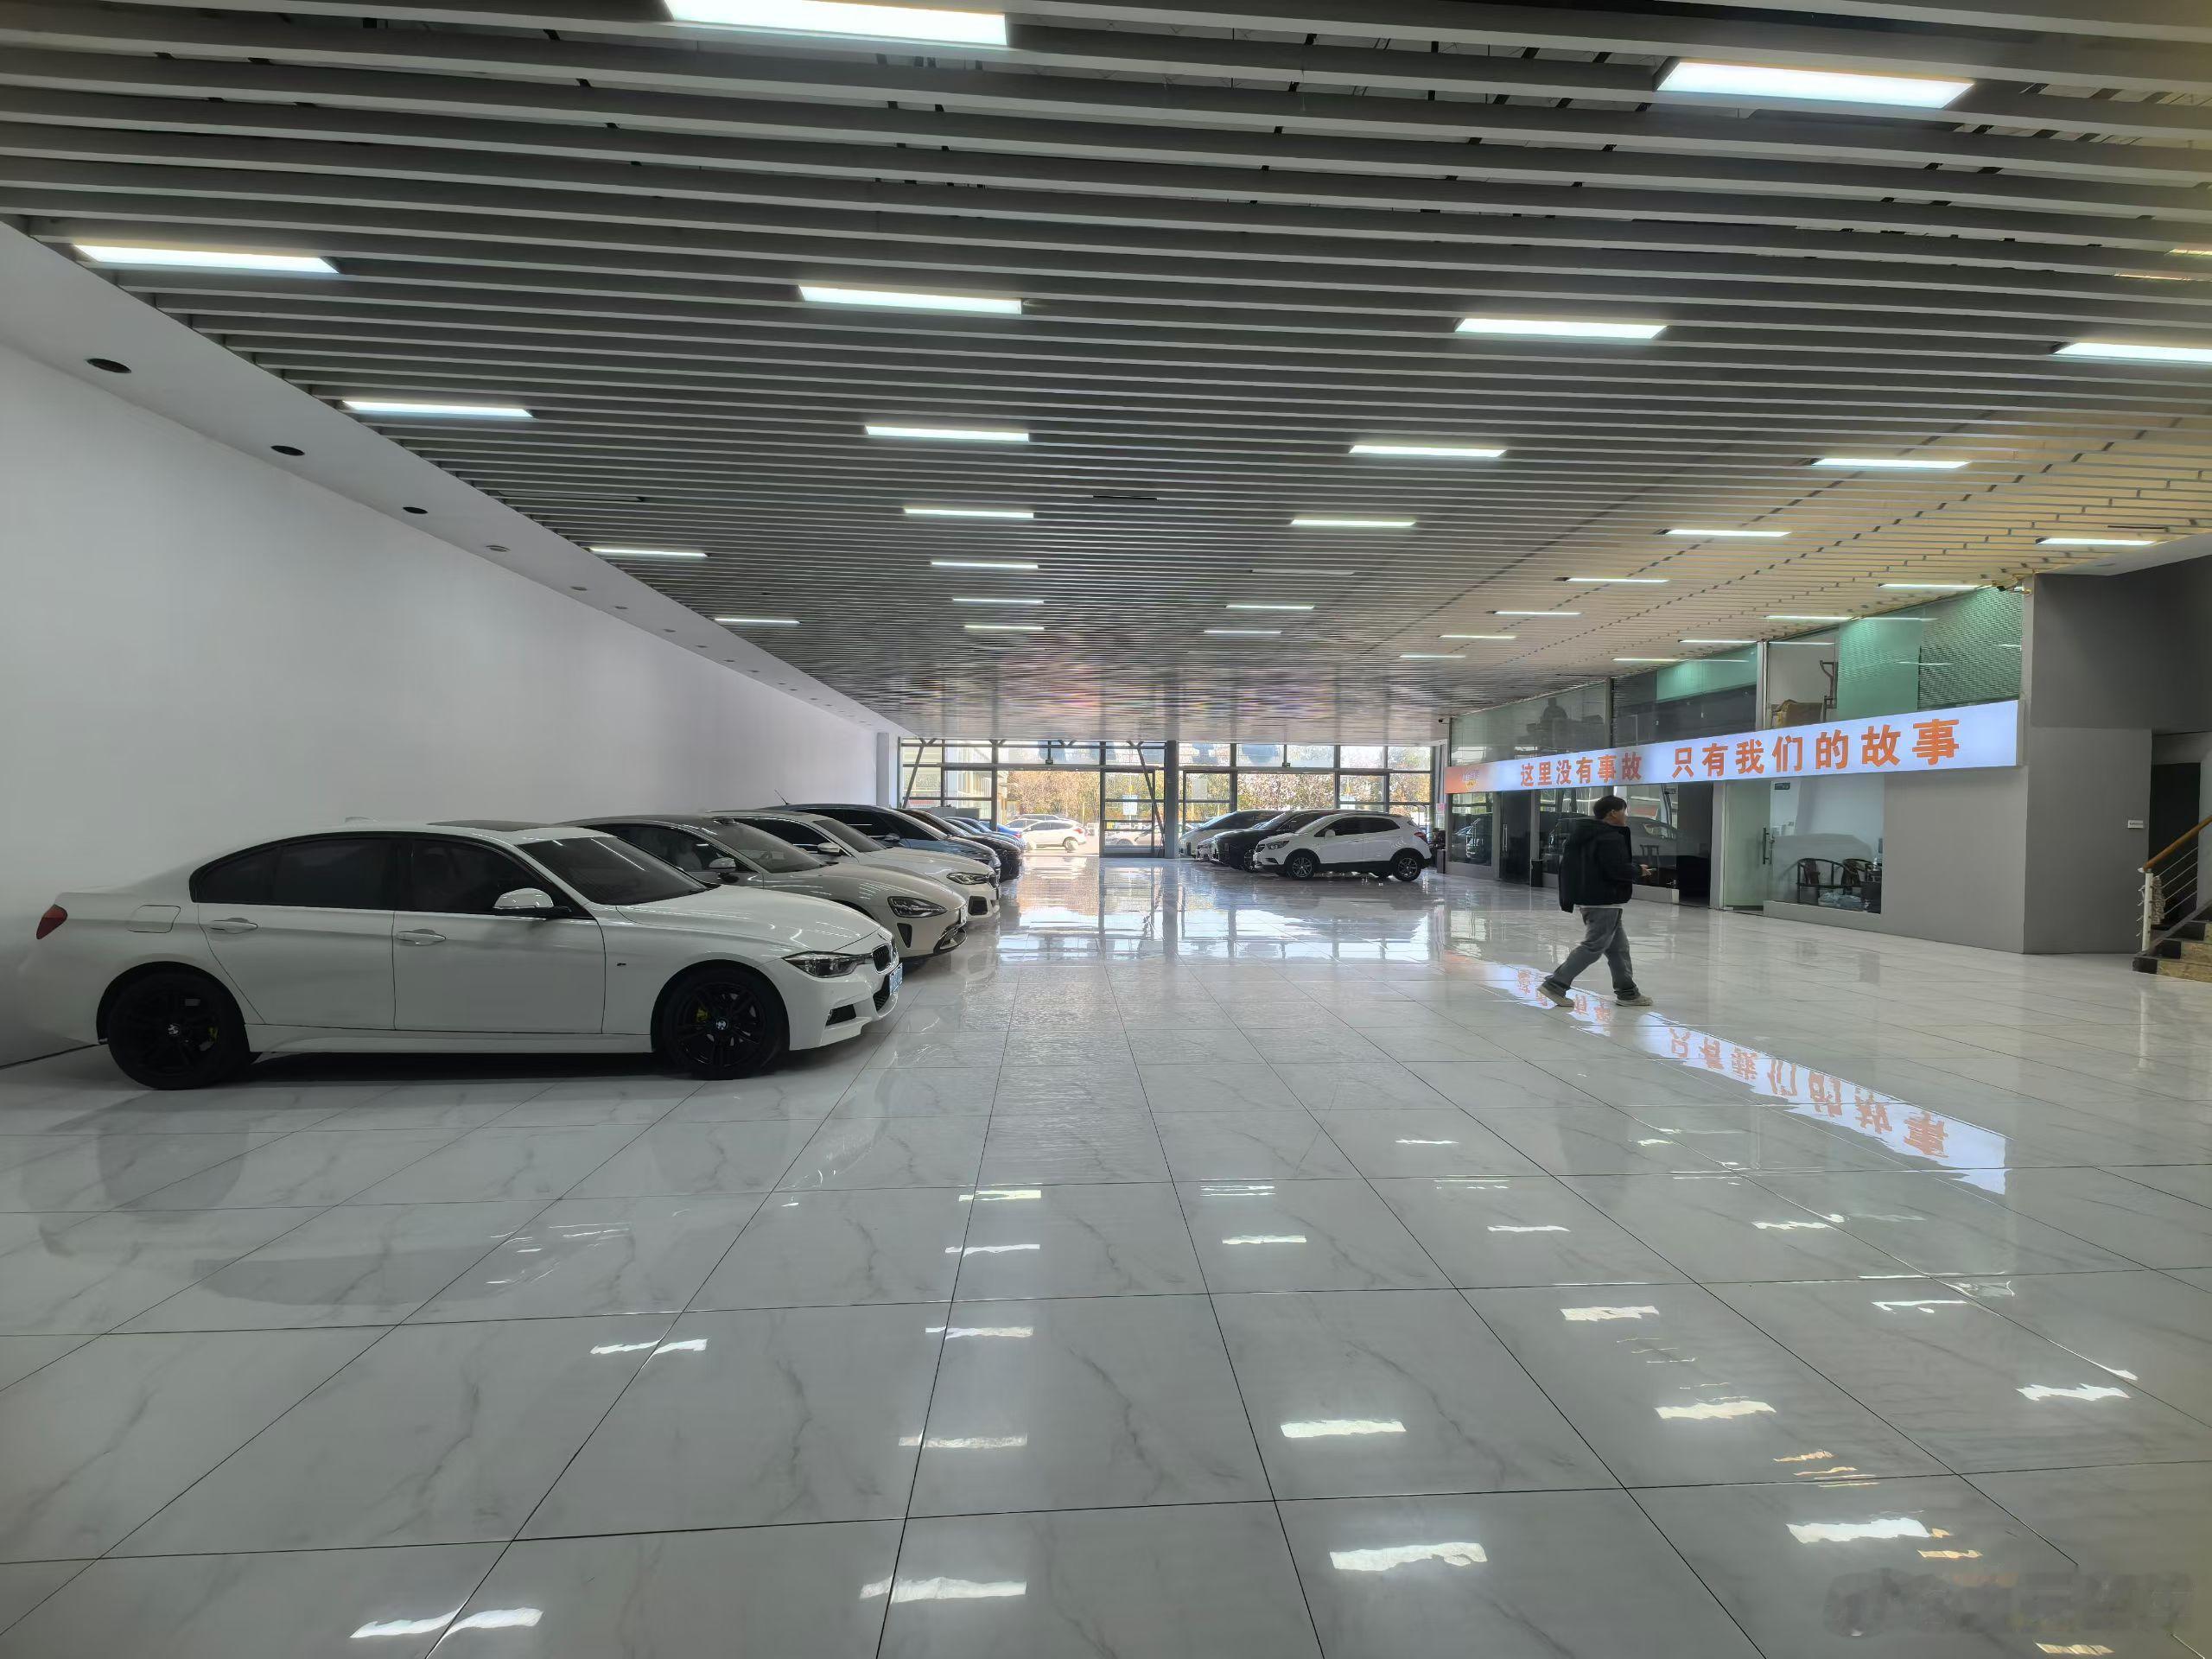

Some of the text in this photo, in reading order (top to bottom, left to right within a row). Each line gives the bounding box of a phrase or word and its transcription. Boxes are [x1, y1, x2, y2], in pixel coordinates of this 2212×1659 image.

[1521, 752, 1642, 787] 这里没有事故
[1672, 718, 1960, 779] 只有我们的故事
